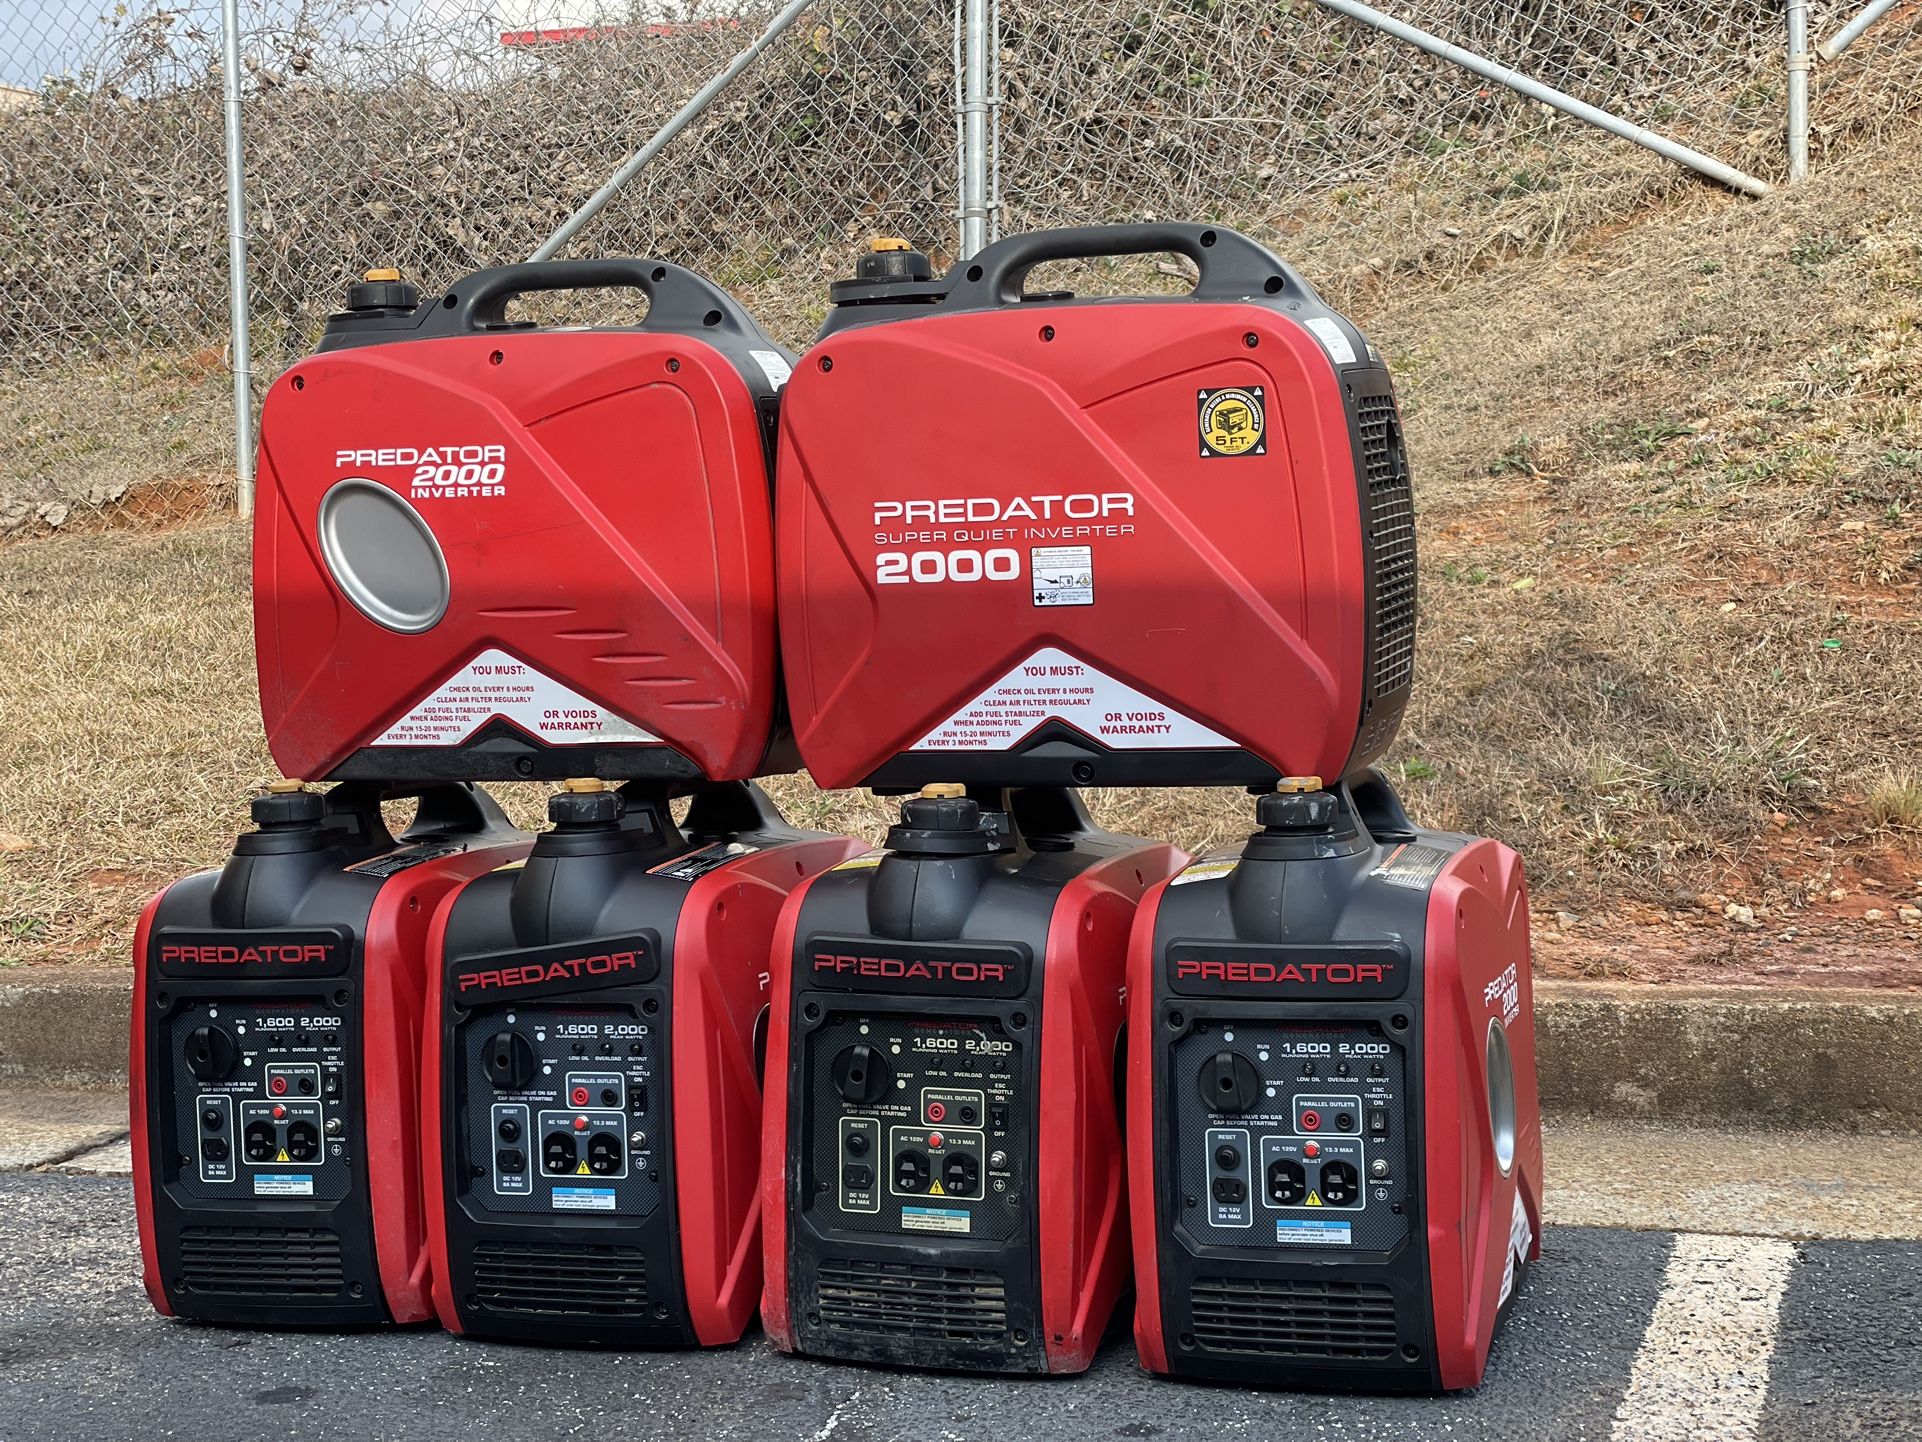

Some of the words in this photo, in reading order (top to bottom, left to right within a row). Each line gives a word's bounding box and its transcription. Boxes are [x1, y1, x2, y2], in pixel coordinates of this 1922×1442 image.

[1215, 436, 1227, 446] 5
[1229, 436, 1250, 445] FT.
[336, 445, 506, 467] PREDATOR
[411, 463, 506, 487] 2000
[411, 486, 506, 498] INVERTER
[874, 492, 1135, 526] PREDATOR
[874, 531, 947, 545] SUPER
[953, 528, 1018, 542] QUIET
[1024, 524, 1135, 539] INVERTER
[876, 548, 1021, 585] 2000
[472, 665, 492, 675] YOU
[495, 665, 526, 675] MUST:
[1024, 666, 1047, 677] YOU
[1049, 666, 1085, 676] MUST:
[1068, 687, 1095, 695] HOURS
[1048, 698, 1091, 706] REGULARLY
[543, 710, 559, 719] OR
[562, 710, 598, 719] VOIDS
[1104, 712, 1123, 722] OR
[1126, 712, 1165, 722] VOIDS
[539, 721, 603, 731] WARRANTY
[975, 719, 1005, 727] ADDING
[1099, 724, 1172, 735] WARRANTY
[928, 739, 950, 747] EVERY
[255, 1017, 294, 1028] 1,600
[300, 1017, 341, 1027] 2,000
[556, 1024, 598, 1034] 1,600
[604, 1024, 648, 1035] 2,000
[913, 1037, 958, 1049] 1,600
[1282, 1042, 1331, 1055] 1,600
[1338, 1043, 1391, 1055] 2,000
